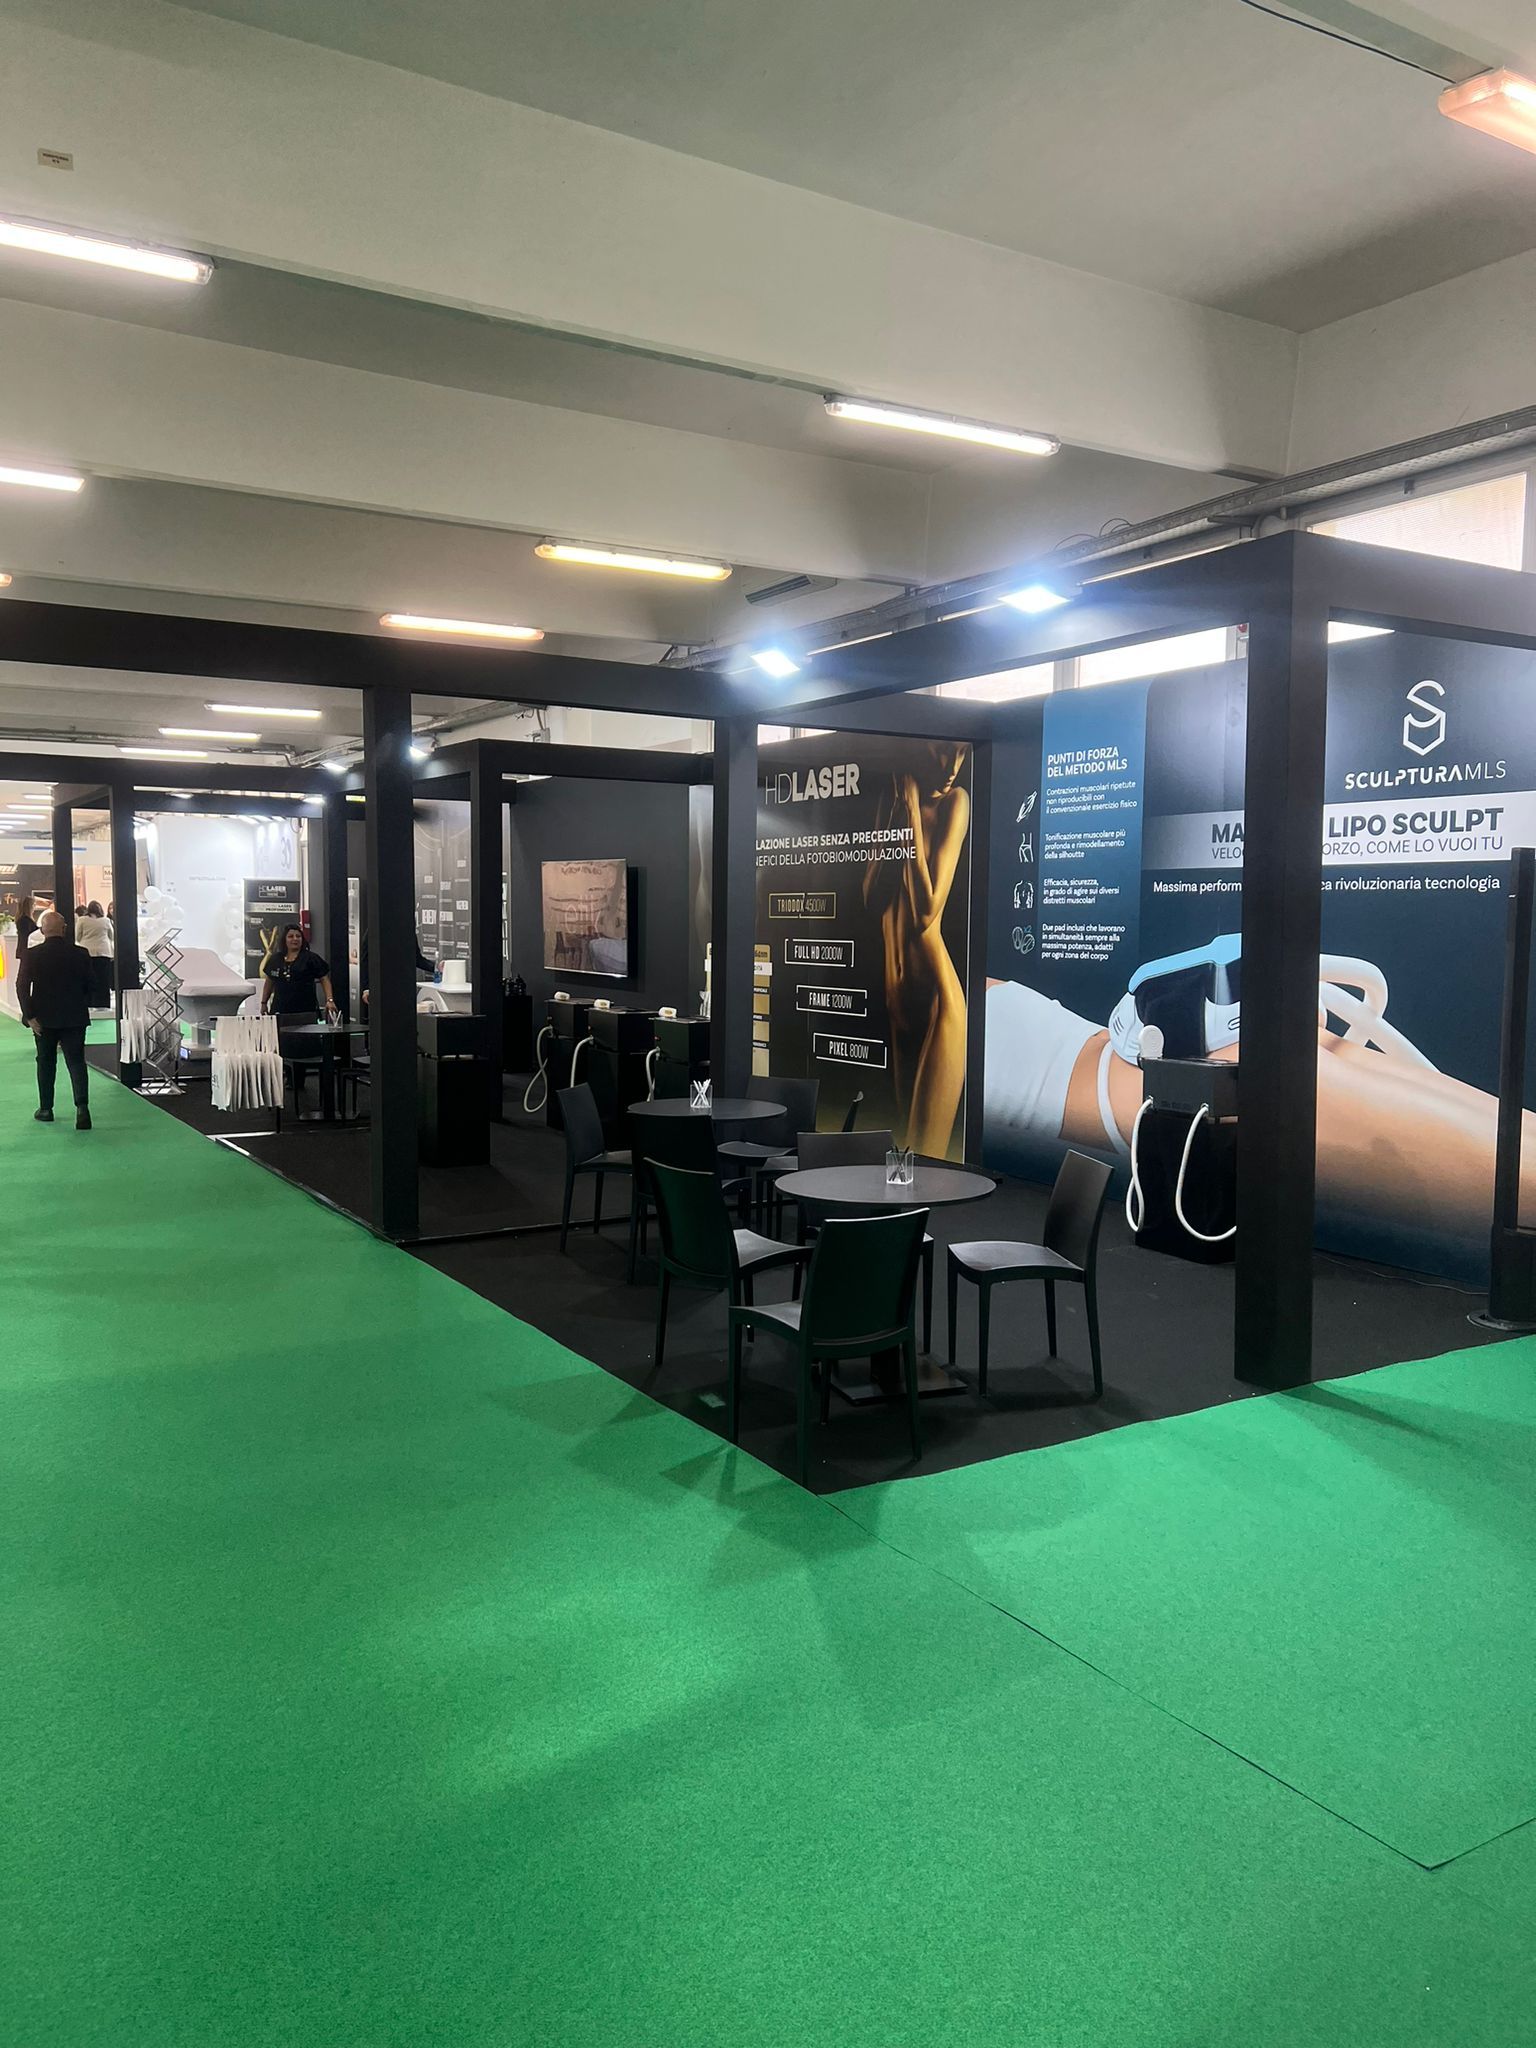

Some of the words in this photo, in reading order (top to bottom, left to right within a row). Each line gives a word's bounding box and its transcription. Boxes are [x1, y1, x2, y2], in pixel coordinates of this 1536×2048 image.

[1047, 751, 1075, 766] PUNTI
[1076, 750, 1086, 762] DI
[1087, 746, 1119, 760] FORZA
[1047, 766, 1064, 778] DEL
[1065, 761, 1105, 776] METODO
[1106, 758, 1128, 771] MLS
[1344, 760, 1506, 790] SCULPTURAMLS
[765, 763, 860, 805] HDLASER
[1046, 785, 1079, 796] Contrazioni
[1079, 783, 1110, 793] muscolari
[1110, 780, 1136, 791] ripetute
[1046, 806, 1050, 814] il
[1050, 803, 1092, 814] convenzionale
[1092, 801, 1119, 811] esercizio
[1119, 800, 1138, 809] fisico
[1058, 793, 1092, 806] riproducibili
[1211, 822, 1244, 844] MA
[1328, 814, 1387, 838] LIPO
[1391, 807, 1504, 835] SCULPT
[791, 835, 819, 849] LASER
[820, 832, 850, 846] SENZA
[852, 827, 914, 844] PRECEDENTI
[1045, 832, 1082, 841] Tonificazione
[1082, 829, 1115, 839] muscolare
[1115, 829, 1126, 838] più
[1044, 842, 1071, 852] profonda
[1076, 839, 1125, 849] rimodellamento
[1211, 846, 1244, 860] VELO
[1366, 840, 1411, 854] COME
[1414, 838, 1435, 853] LO
[1438, 837, 1477, 852] VUOI
[1481, 835, 1503, 850] TU
[779, 853, 806, 865] DELLA
[806, 846, 917, 864] FOTOBIOMODULAZIONE
[1044, 851, 1058, 859] della
[1043, 878, 1069, 887] Efficacia,
[1069, 878, 1099, 886] sicurezza,
[1153, 880, 1198, 893] Massima
[1199, 879, 1242, 895] perform
[1335, 876, 1422, 891] rivoluzionaria
[1425, 874, 1501, 893] tecnologia
[1049, 887, 1066, 897] grado
[1067, 887, 1073, 895] di
[1073, 887, 1088, 896] agire
[1089, 887, 1098, 895] sui
[1098, 886, 1119, 895] diversi
[1043, 896, 1066, 904] distretti
[1066, 896, 1096, 904] muscolari
[1042, 923, 1054, 931] Due
[1054, 923, 1066, 933] pad
[1066, 923, 1085, 932] inclusi
[1085, 924, 1098, 932] che
[1098, 924, 1126, 932] lavorano
[1042, 932, 1048, 940] in
[1048, 932, 1084, 941] simultaneità
[1084, 934, 1108, 943] sempre
[1108, 933, 1120, 942] alla
[794, 945, 810, 960] FULL
[810, 946, 820, 960] HD
[820, 946, 844, 961] 2000W
[1041, 942, 1067, 950] massima
[1067, 942, 1094, 952] potenza,
[1094, 942, 1114, 951] adatti
[1041, 951, 1051, 960] per
[1051, 951, 1064, 960] ogni
[1079, 951, 1090, 960] del
[1090, 952, 1109, 962] corpo
[809, 992, 831, 1007] FRAME
[831, 994, 853, 1009] 1200W
[829, 1041, 848, 1057] PIXEL
[849, 1044, 870, 1060] 800W
